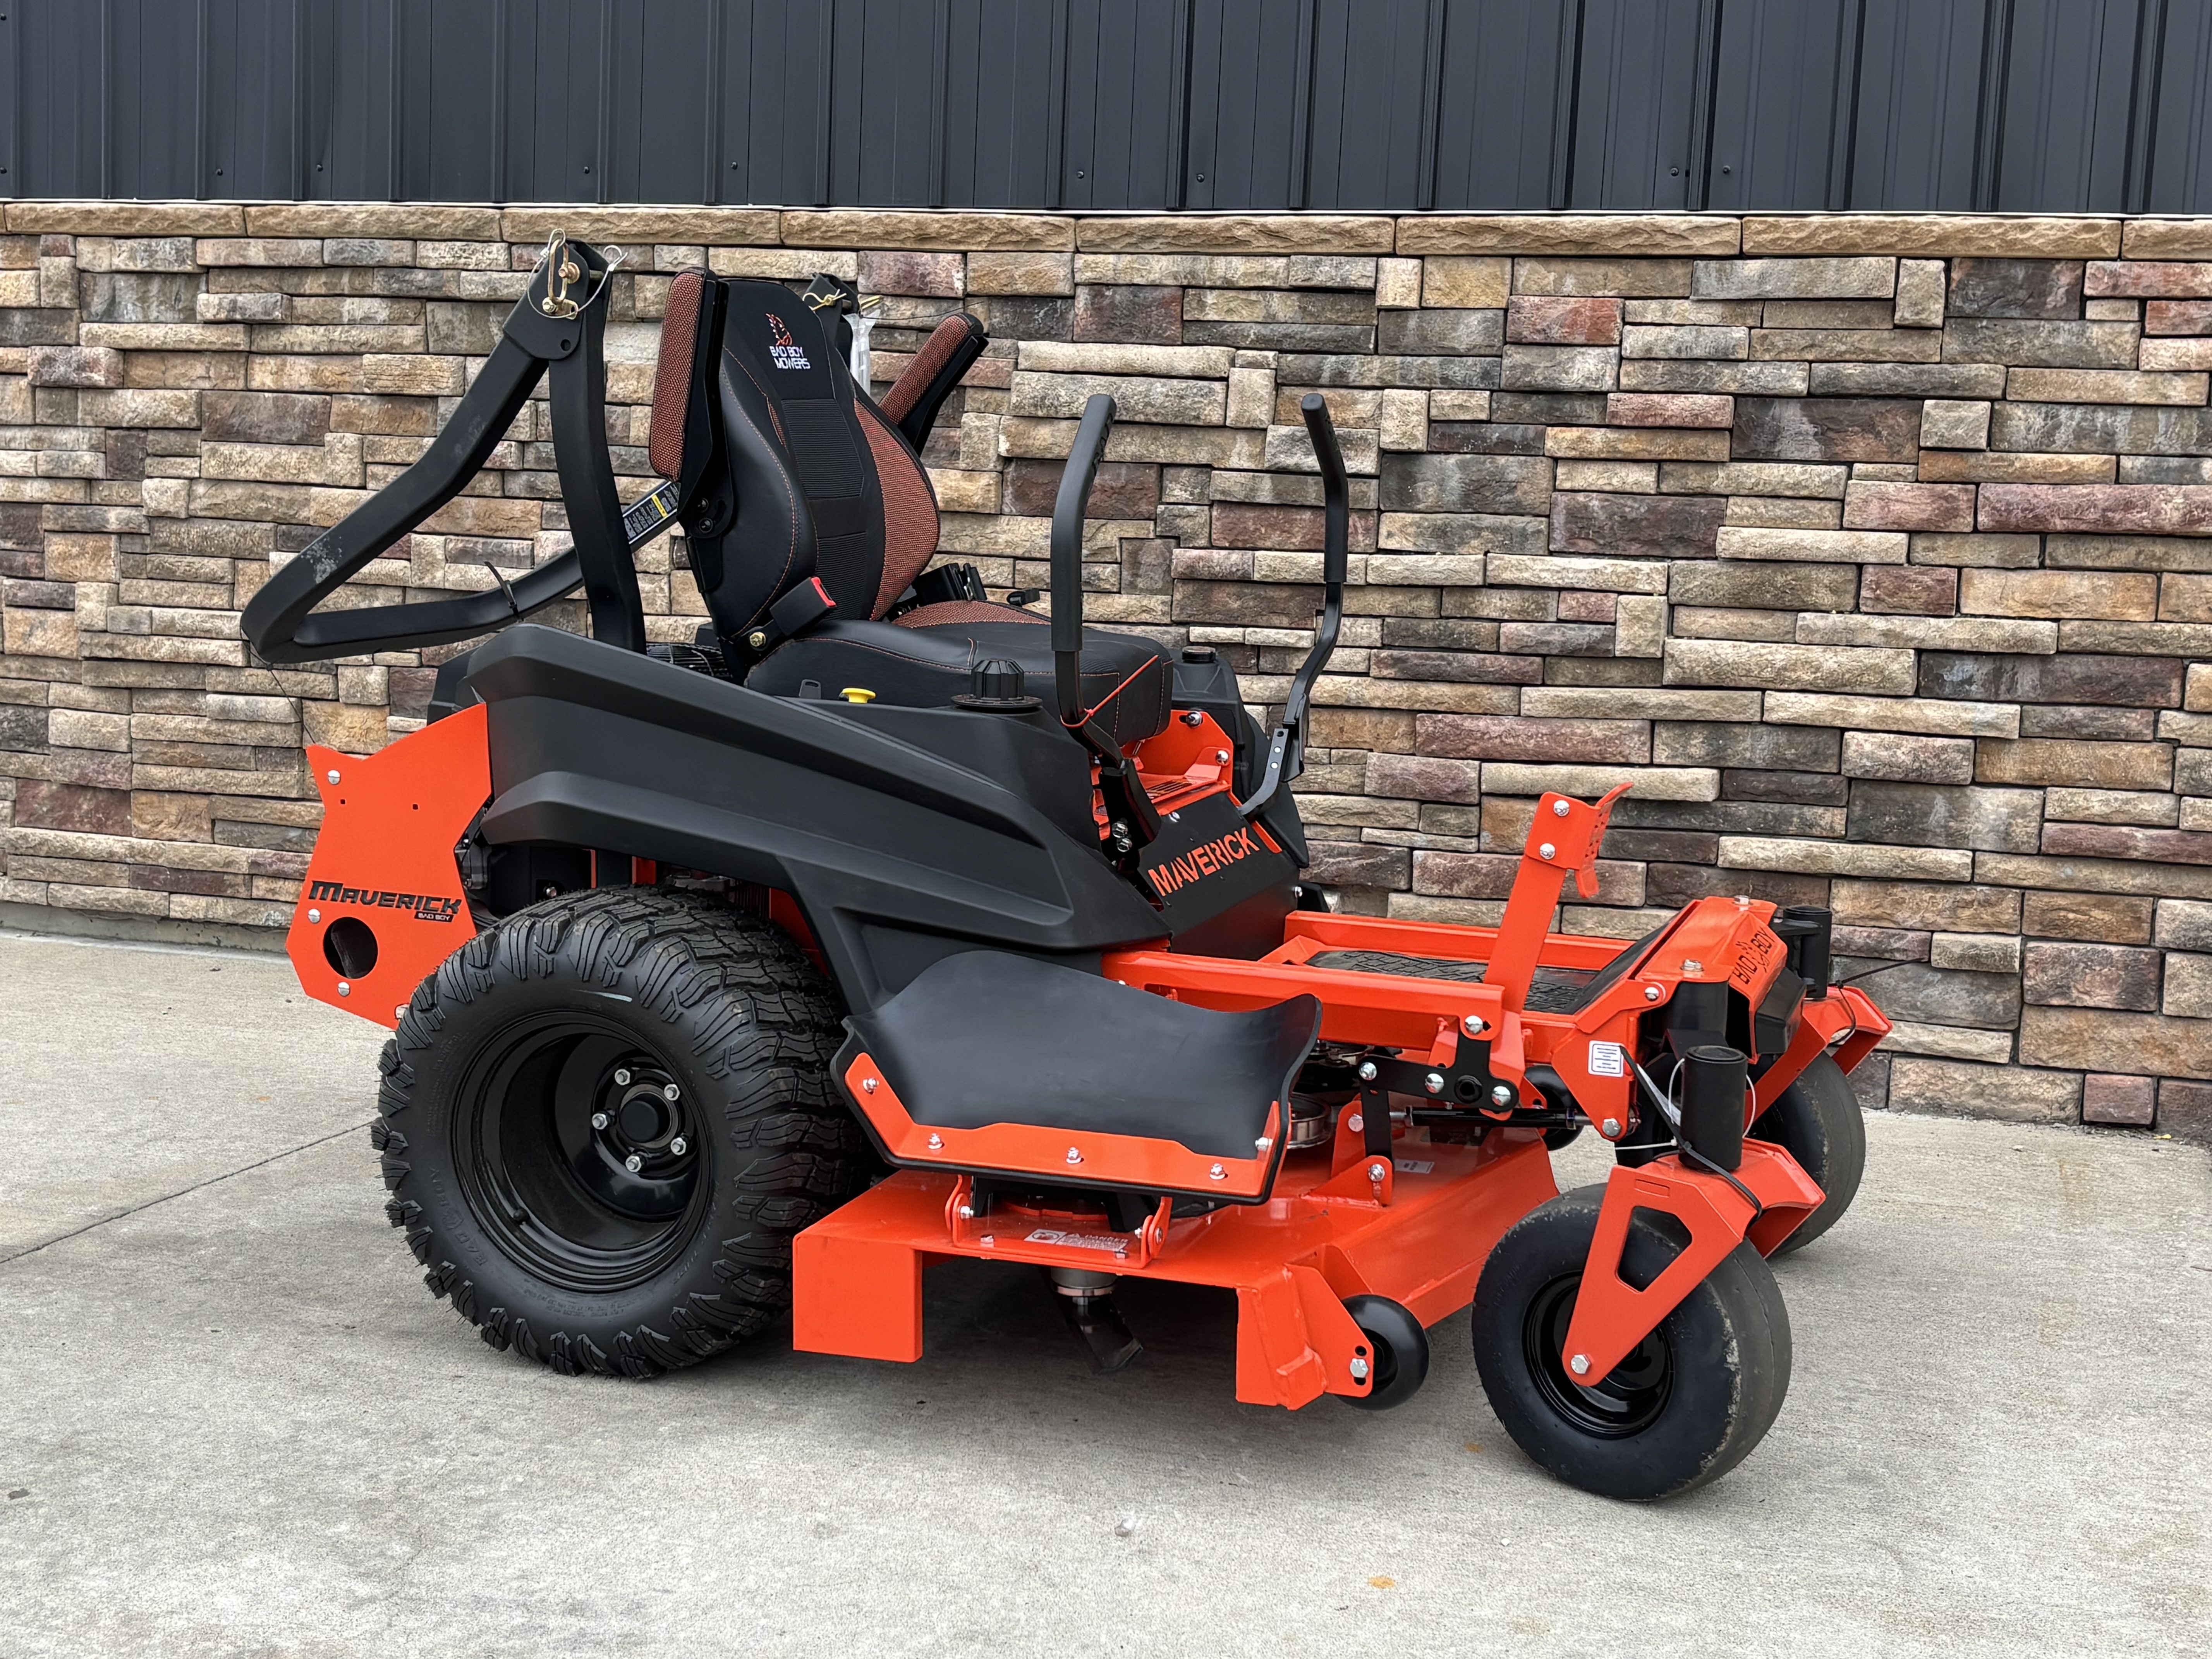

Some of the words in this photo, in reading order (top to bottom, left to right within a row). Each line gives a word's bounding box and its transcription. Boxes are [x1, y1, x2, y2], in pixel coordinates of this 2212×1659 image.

[769, 346, 787, 357] BAD
[787, 346, 804, 357] BOY
[774, 357, 811, 369] MOWERS
[1148, 827, 1260, 897] MAVERICK
[308, 880, 462, 914] MAVERICK
[1732, 955, 1758, 985] BAD
[1750, 926, 1776, 954] BOY
